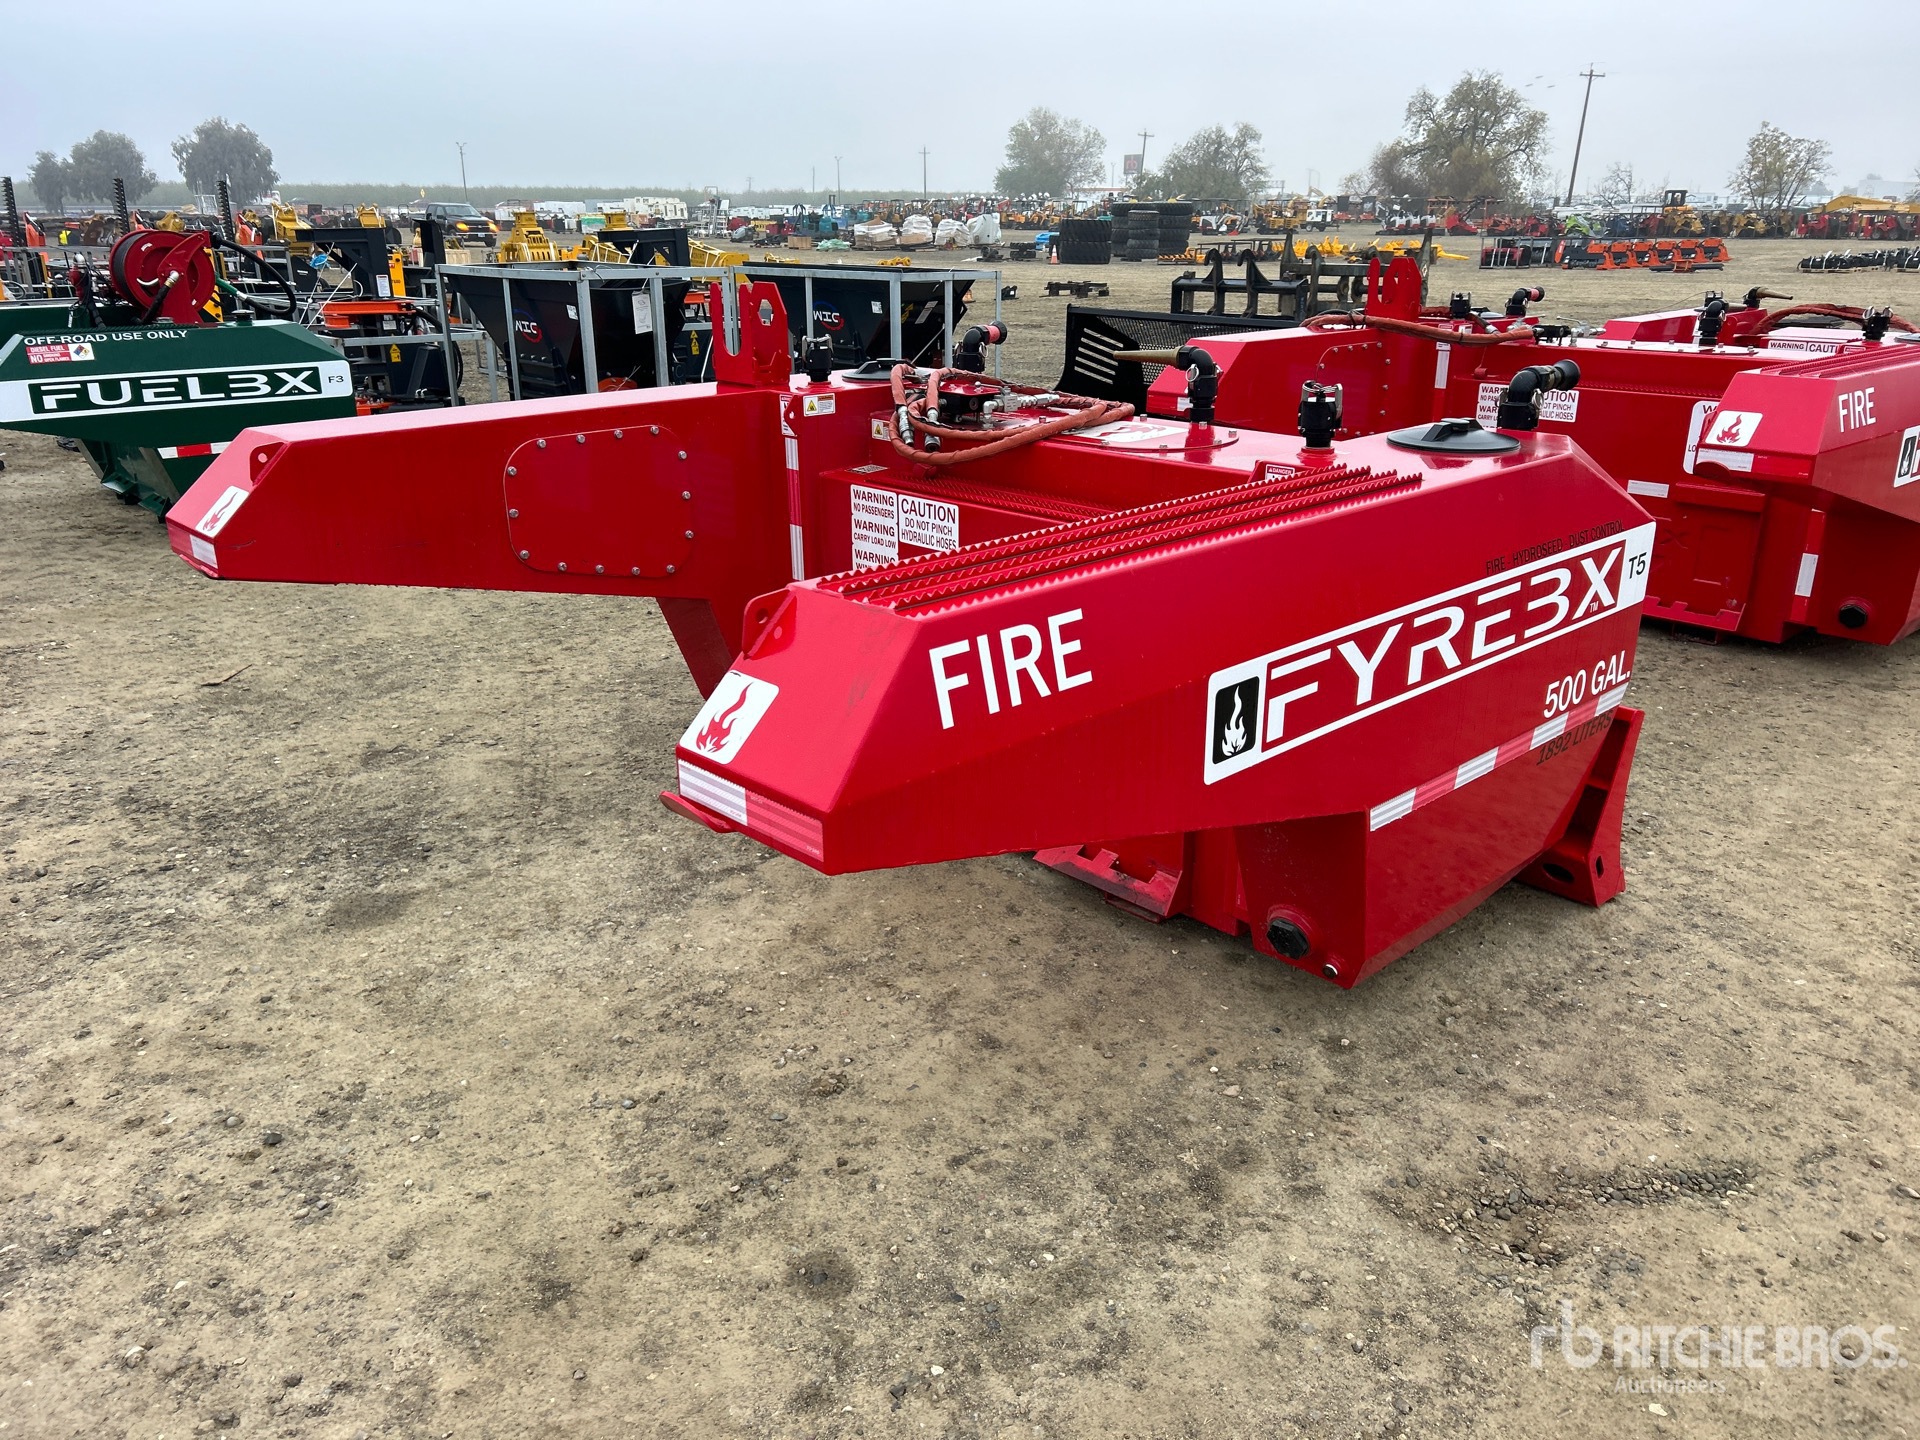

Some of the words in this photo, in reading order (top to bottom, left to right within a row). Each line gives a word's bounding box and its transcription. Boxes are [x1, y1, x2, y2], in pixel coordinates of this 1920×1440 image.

[23, 333, 107, 346] OFF-ROAD
[111, 331, 144, 341] USE
[147, 330, 188, 340] ONLY
[1770, 342, 1804, 350] WARNING
[1808, 344, 1838, 353] CAUTI
[30, 354, 44, 363] NO
[328, 375, 344, 384] F3
[1545, 390, 1577, 403] UTION
[1539, 410, 1554, 419] AULIC
[1555, 411, 1574, 420] HOSES
[1552, 402, 1572, 412] PINCH
[1838, 387, 1876, 433] FIRE
[1478, 414, 1492, 422] CARRY
[853, 488, 894, 507] WARNING
[853, 502, 861, 512] NO
[861, 503, 894, 519] PASSENGERS
[901, 498, 956, 524] CAUTION
[853, 518, 895, 537] WARNING
[904, 517, 914, 528] DO
[916, 519, 930, 531] NOT
[931, 522, 952, 536] PINCH
[853, 532, 870, 542] CARRY
[871, 535, 884, 546] LOAD
[885, 539, 896, 549] LOW
[901, 529, 935, 547] HYDRAULIC
[936, 537, 957, 550] HOSES
[1486, 556, 1505, 576] FIRE
[1512, 539, 1563, 567] HYDROSEED
[1569, 530, 1589, 548] DUST
[1591, 520, 1625, 541] CONTROL
[1629, 552, 1647, 580] T5
[928, 608, 1093, 730] FIRE
[1543, 669, 1587, 718] 500
[1591, 650, 1631, 695] GAL.
[1536, 731, 1572, 766] 1892
[1573, 710, 1614, 746] LITERS
